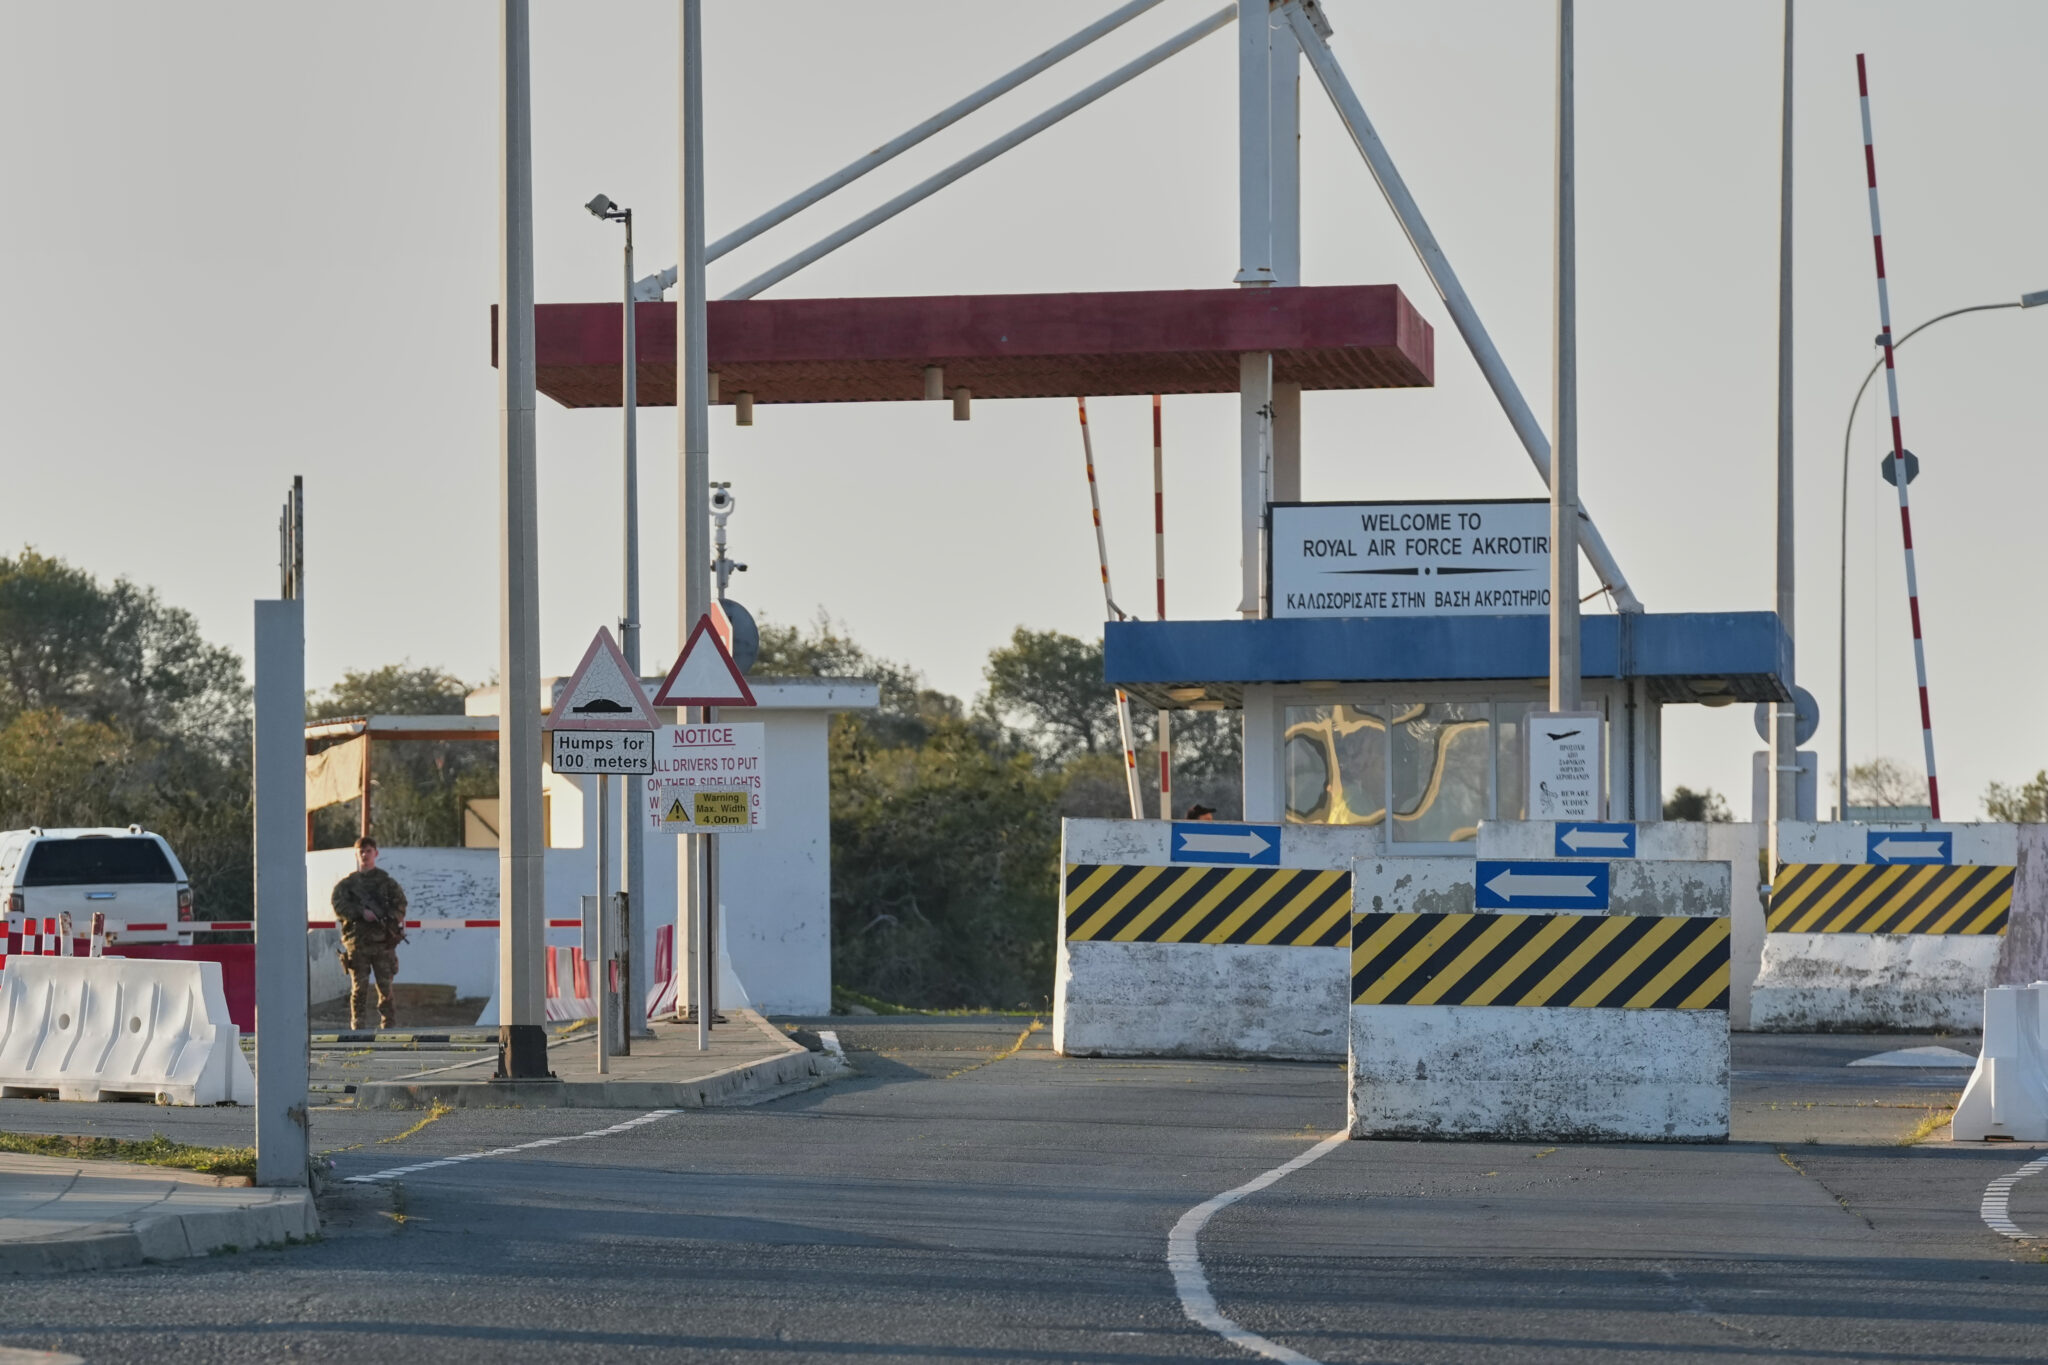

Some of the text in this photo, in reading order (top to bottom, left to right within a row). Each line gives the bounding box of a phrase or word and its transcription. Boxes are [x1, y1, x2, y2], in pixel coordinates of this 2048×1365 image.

[1361, 512, 1482, 531] WELCOME TO
[1303, 539, 1357, 557] ROYAL
[1367, 538, 1396, 556] AIR
[1405, 537, 1462, 556] FORCE
[1287, 592, 1387, 610] ΚΑΛΩΣΟΡΙΣΑΤΕ
[1391, 591, 1426, 608] ΣΤΗΝ
[1434, 590, 1470, 608] ΒΑΣΗ
[559, 736, 645, 752] Humps for
[674, 728, 733, 744] NOTICE
[556, 754, 648, 768] 100 meters
[653, 756, 758, 772] ALL DRIVERS TO PUT
[647, 778, 662, 792] ON
[702, 793, 740, 803] Warning
[696, 803, 746, 813] Max. Width
[703, 815, 740, 824] 4.00m
